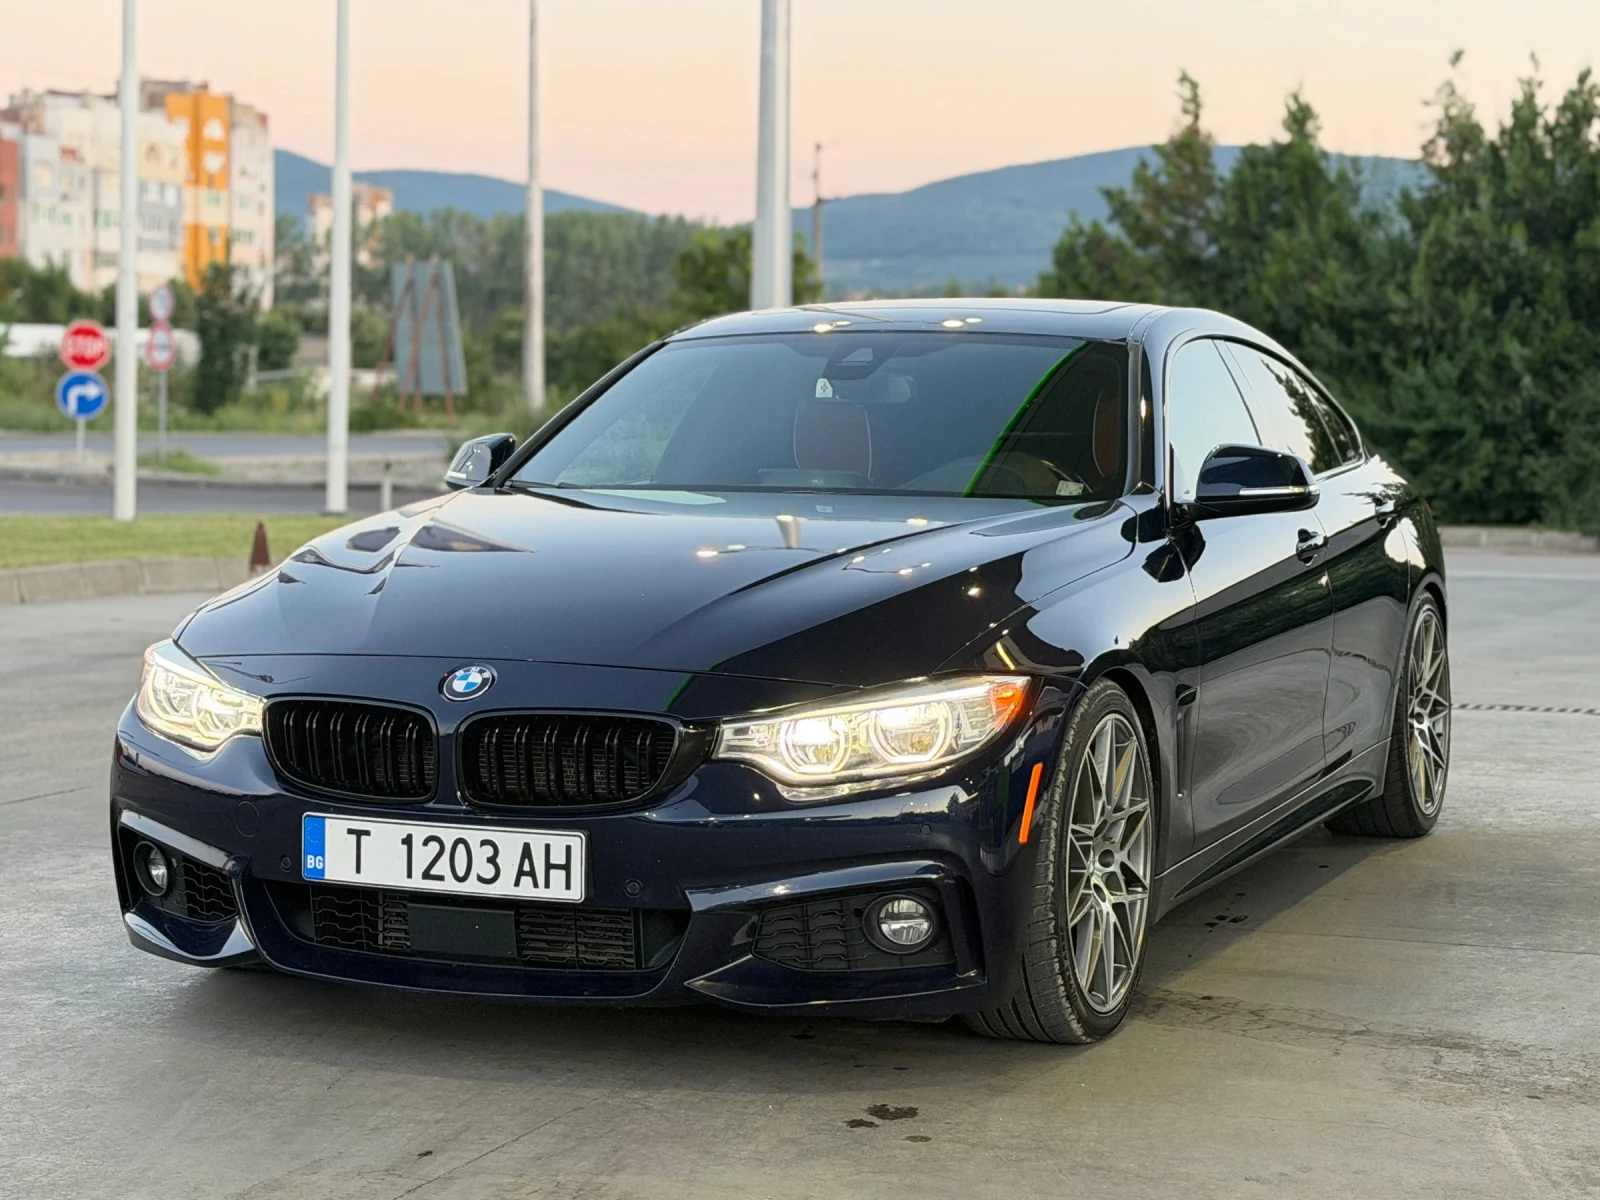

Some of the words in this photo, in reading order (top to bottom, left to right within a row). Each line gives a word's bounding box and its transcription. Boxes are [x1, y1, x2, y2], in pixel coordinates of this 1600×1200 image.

[64, 335, 104, 356] STOP
[455, 666, 491, 679] BMW
[306, 855, 324, 869] BG
[346, 827, 371, 874] T
[401, 833, 501, 885] 1203
[513, 841, 572, 891] AH
